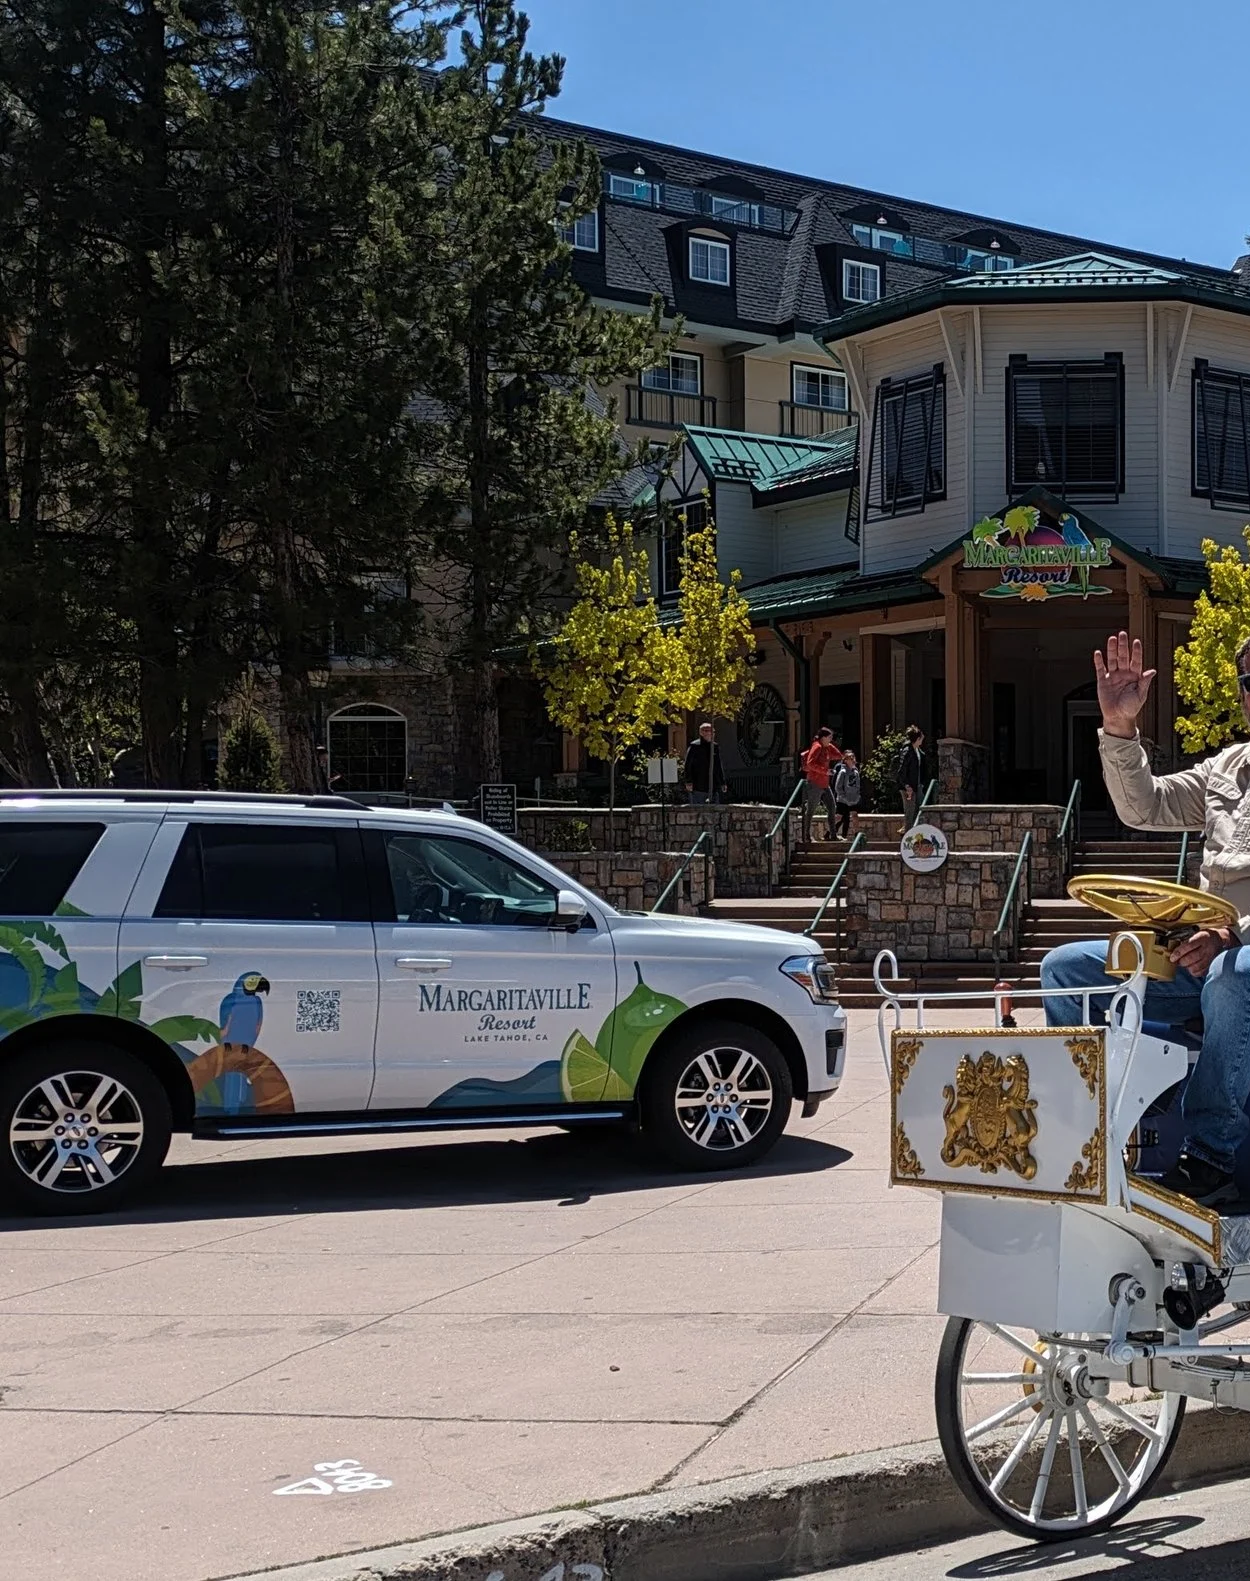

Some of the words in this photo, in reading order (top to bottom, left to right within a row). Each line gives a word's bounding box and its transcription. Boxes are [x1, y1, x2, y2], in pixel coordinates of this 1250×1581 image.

[963, 538, 1112, 567] MARGARITAVILLE
[1002, 567, 1070, 584] Resort
[418, 983, 592, 1012] MARGARITAVILLE
[477, 1013, 537, 1031] Resort
[464, 1035, 490, 1043] LAKE
[493, 1034, 532, 1043] TAHOE,
